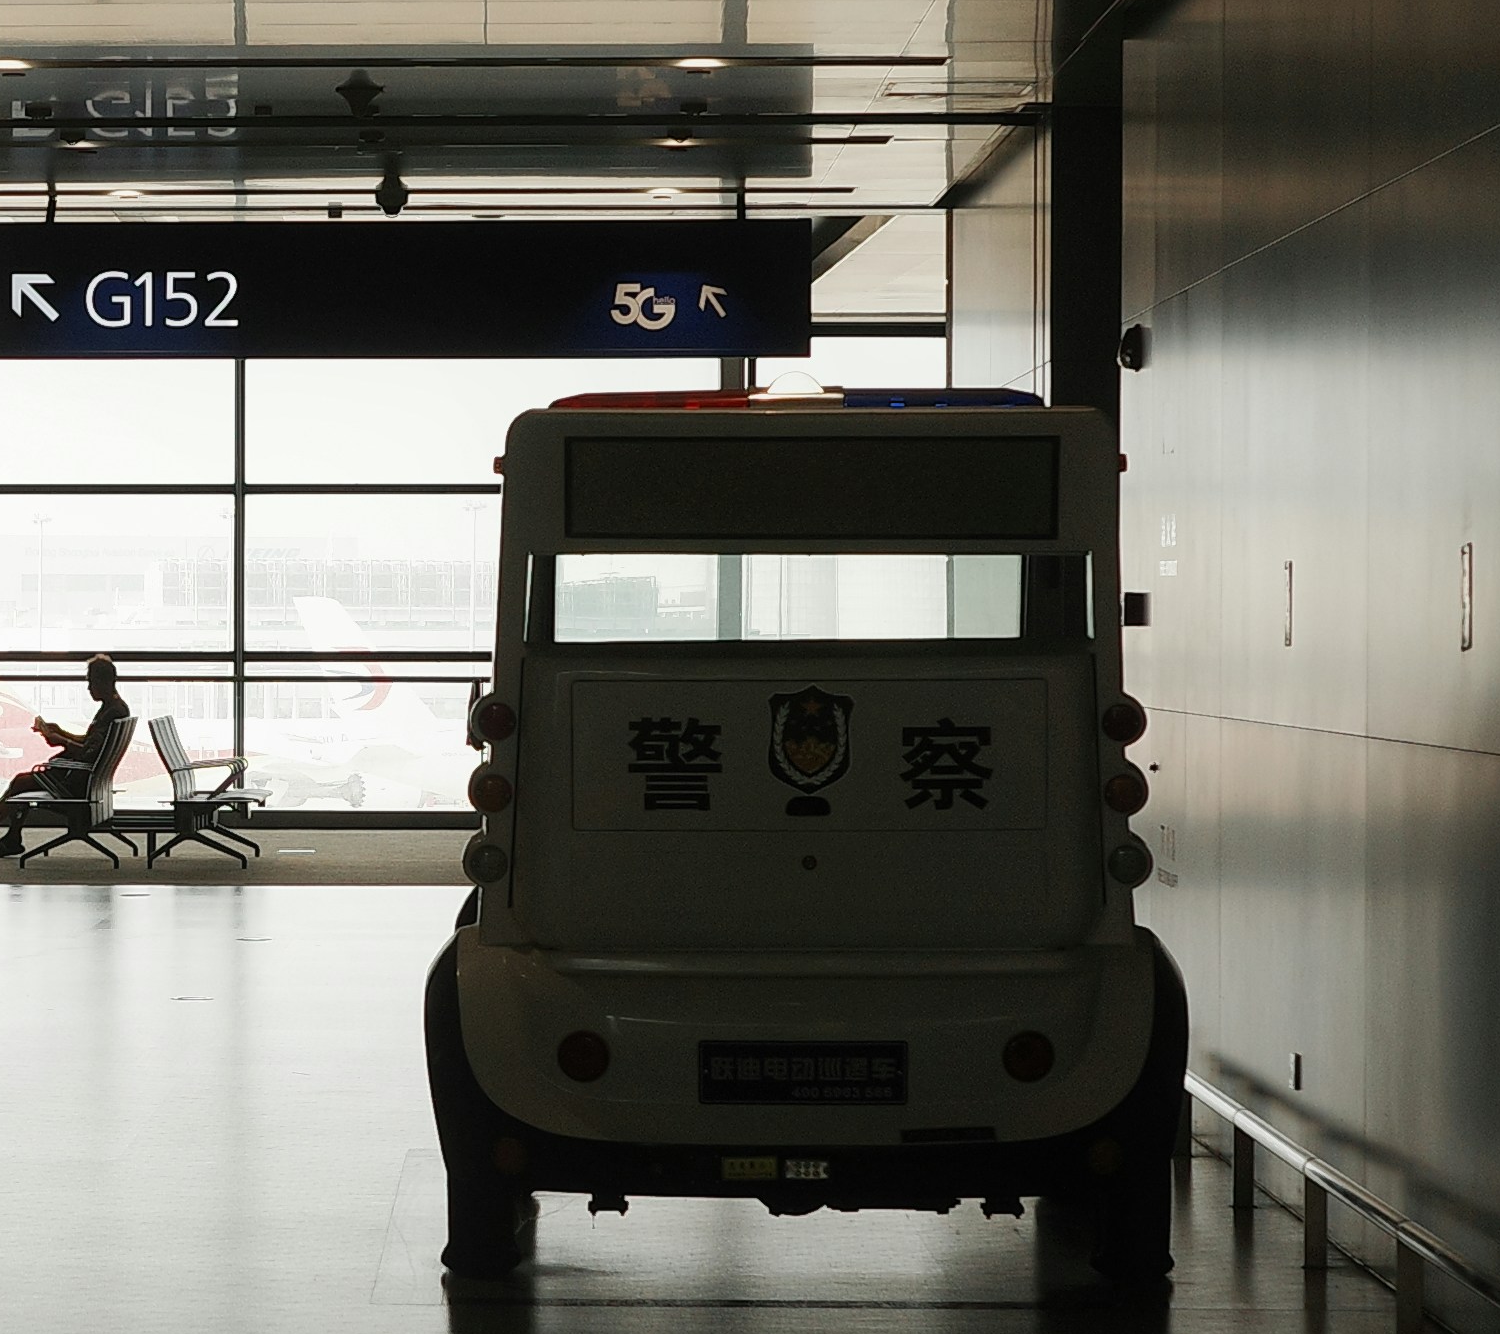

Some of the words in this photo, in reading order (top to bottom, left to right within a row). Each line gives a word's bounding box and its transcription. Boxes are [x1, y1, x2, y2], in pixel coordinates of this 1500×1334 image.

[84, 270, 240, 328] G152
[610, 283, 676, 331] 5G
[627, 717, 722, 811] 警
[899, 717, 993, 811] 察
